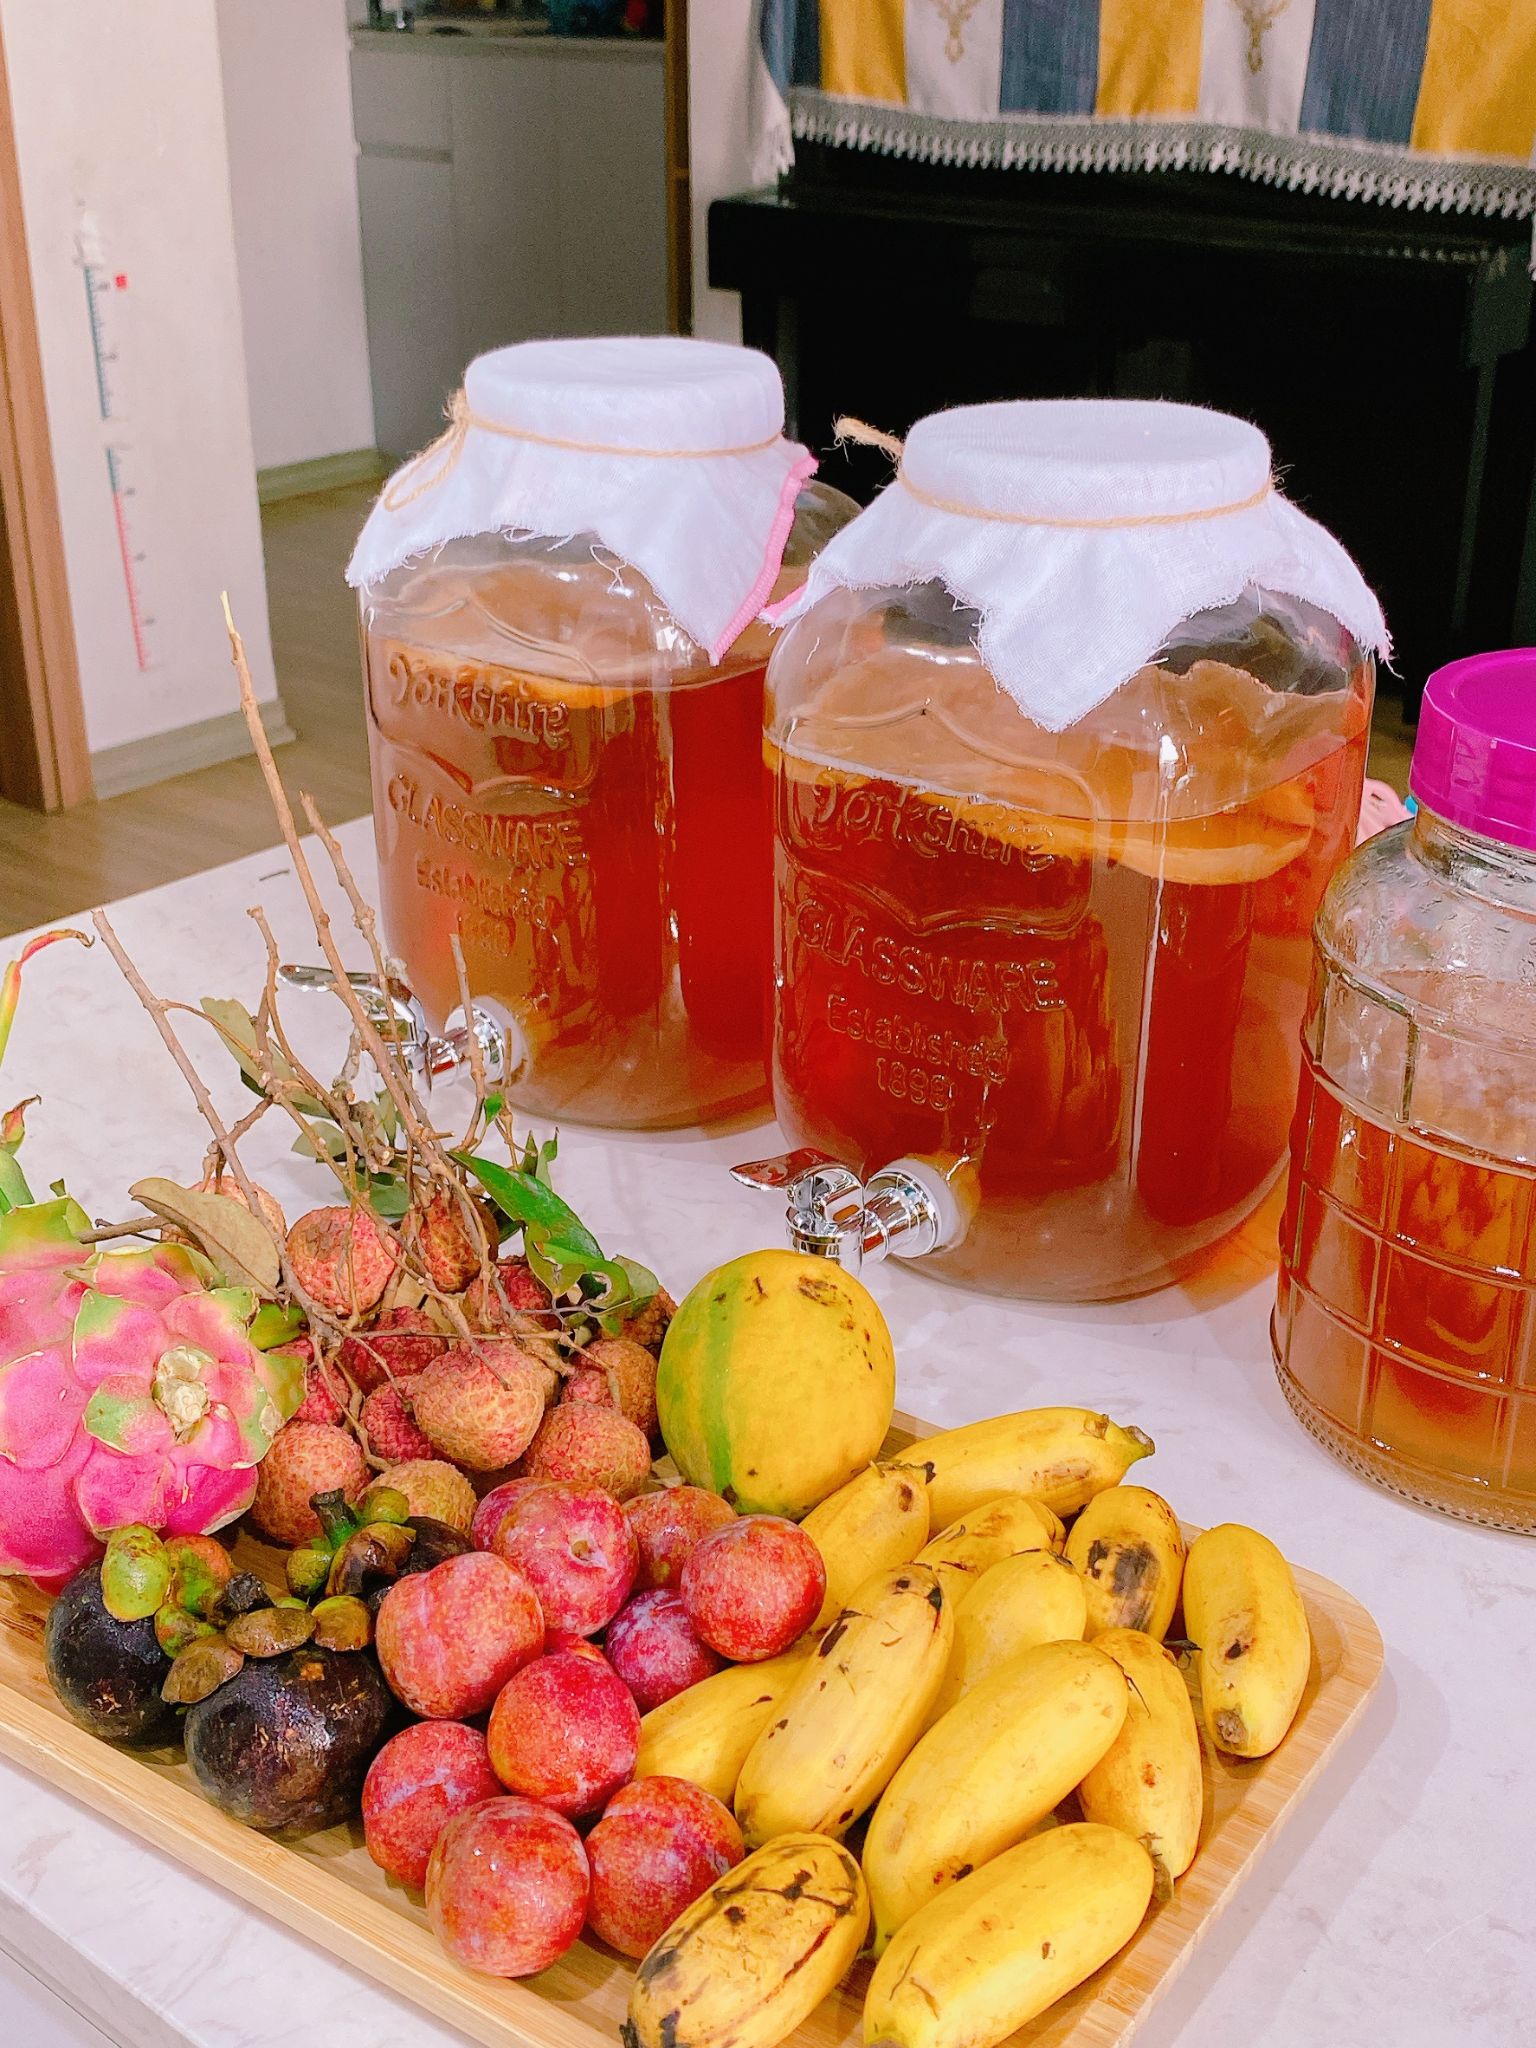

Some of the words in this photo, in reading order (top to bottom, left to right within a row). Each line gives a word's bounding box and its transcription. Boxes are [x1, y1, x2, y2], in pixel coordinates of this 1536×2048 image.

[388, 774, 589, 869] GLASSWARE
[796, 899, 1067, 1013] GLASSWARE
[827, 993, 1012, 1085] Established
